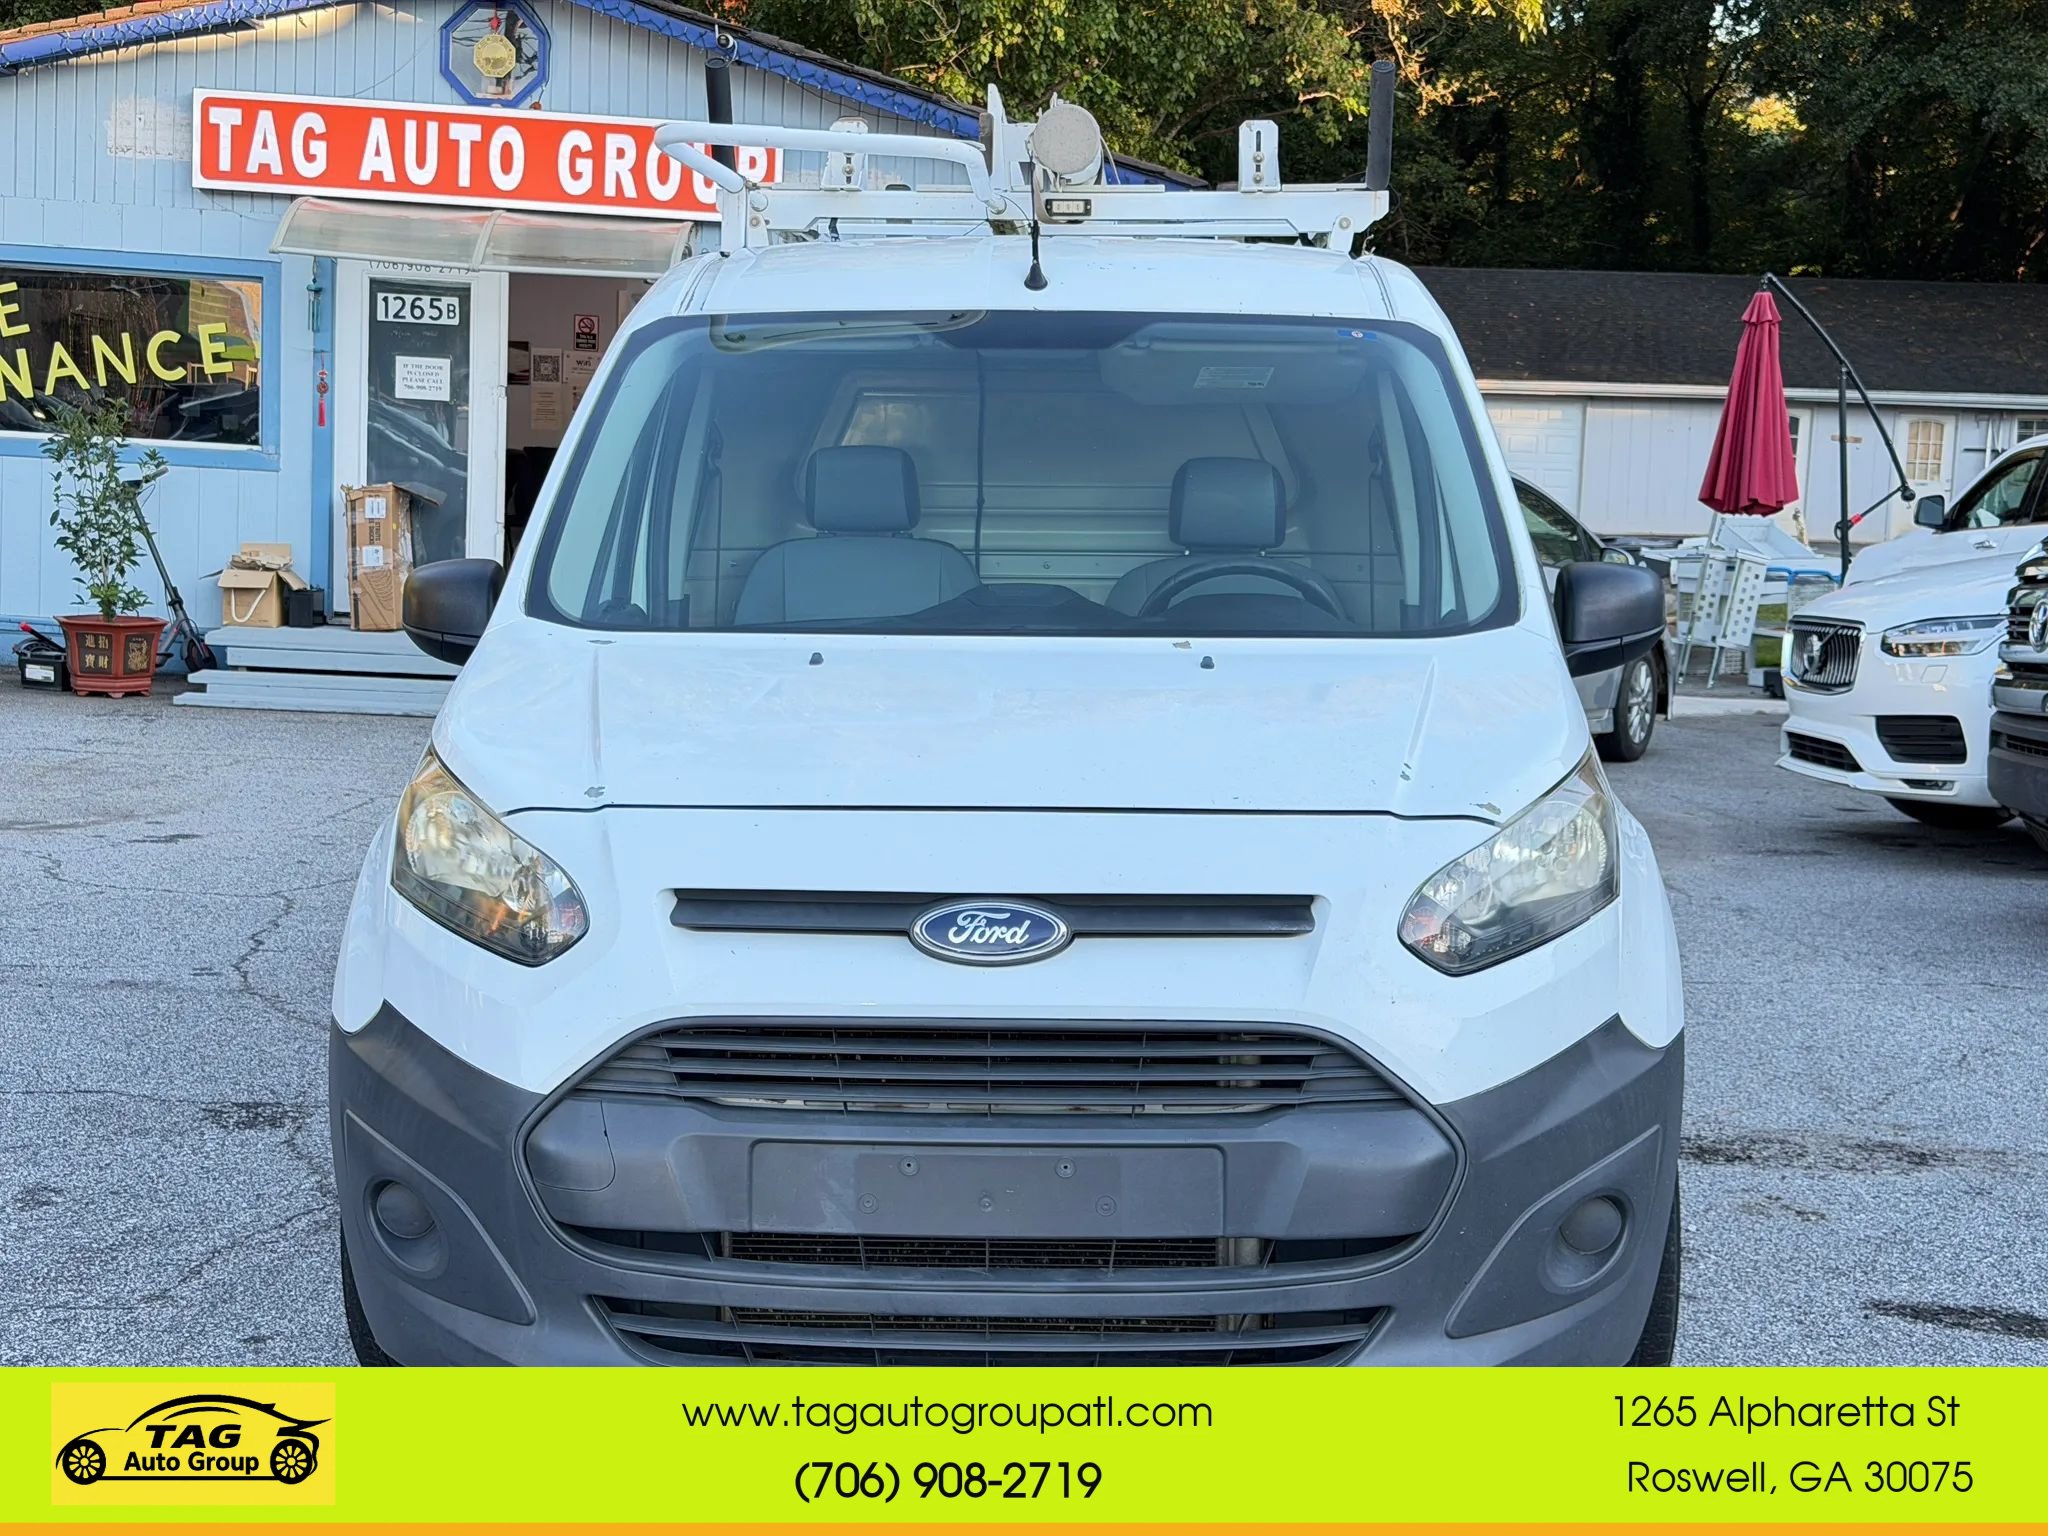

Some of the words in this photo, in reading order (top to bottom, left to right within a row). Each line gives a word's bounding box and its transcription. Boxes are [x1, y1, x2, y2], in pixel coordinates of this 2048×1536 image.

[208, 107, 327, 179] TAG
[359, 117, 525, 192] AUTO
[948, 911, 1031, 944] Ford
